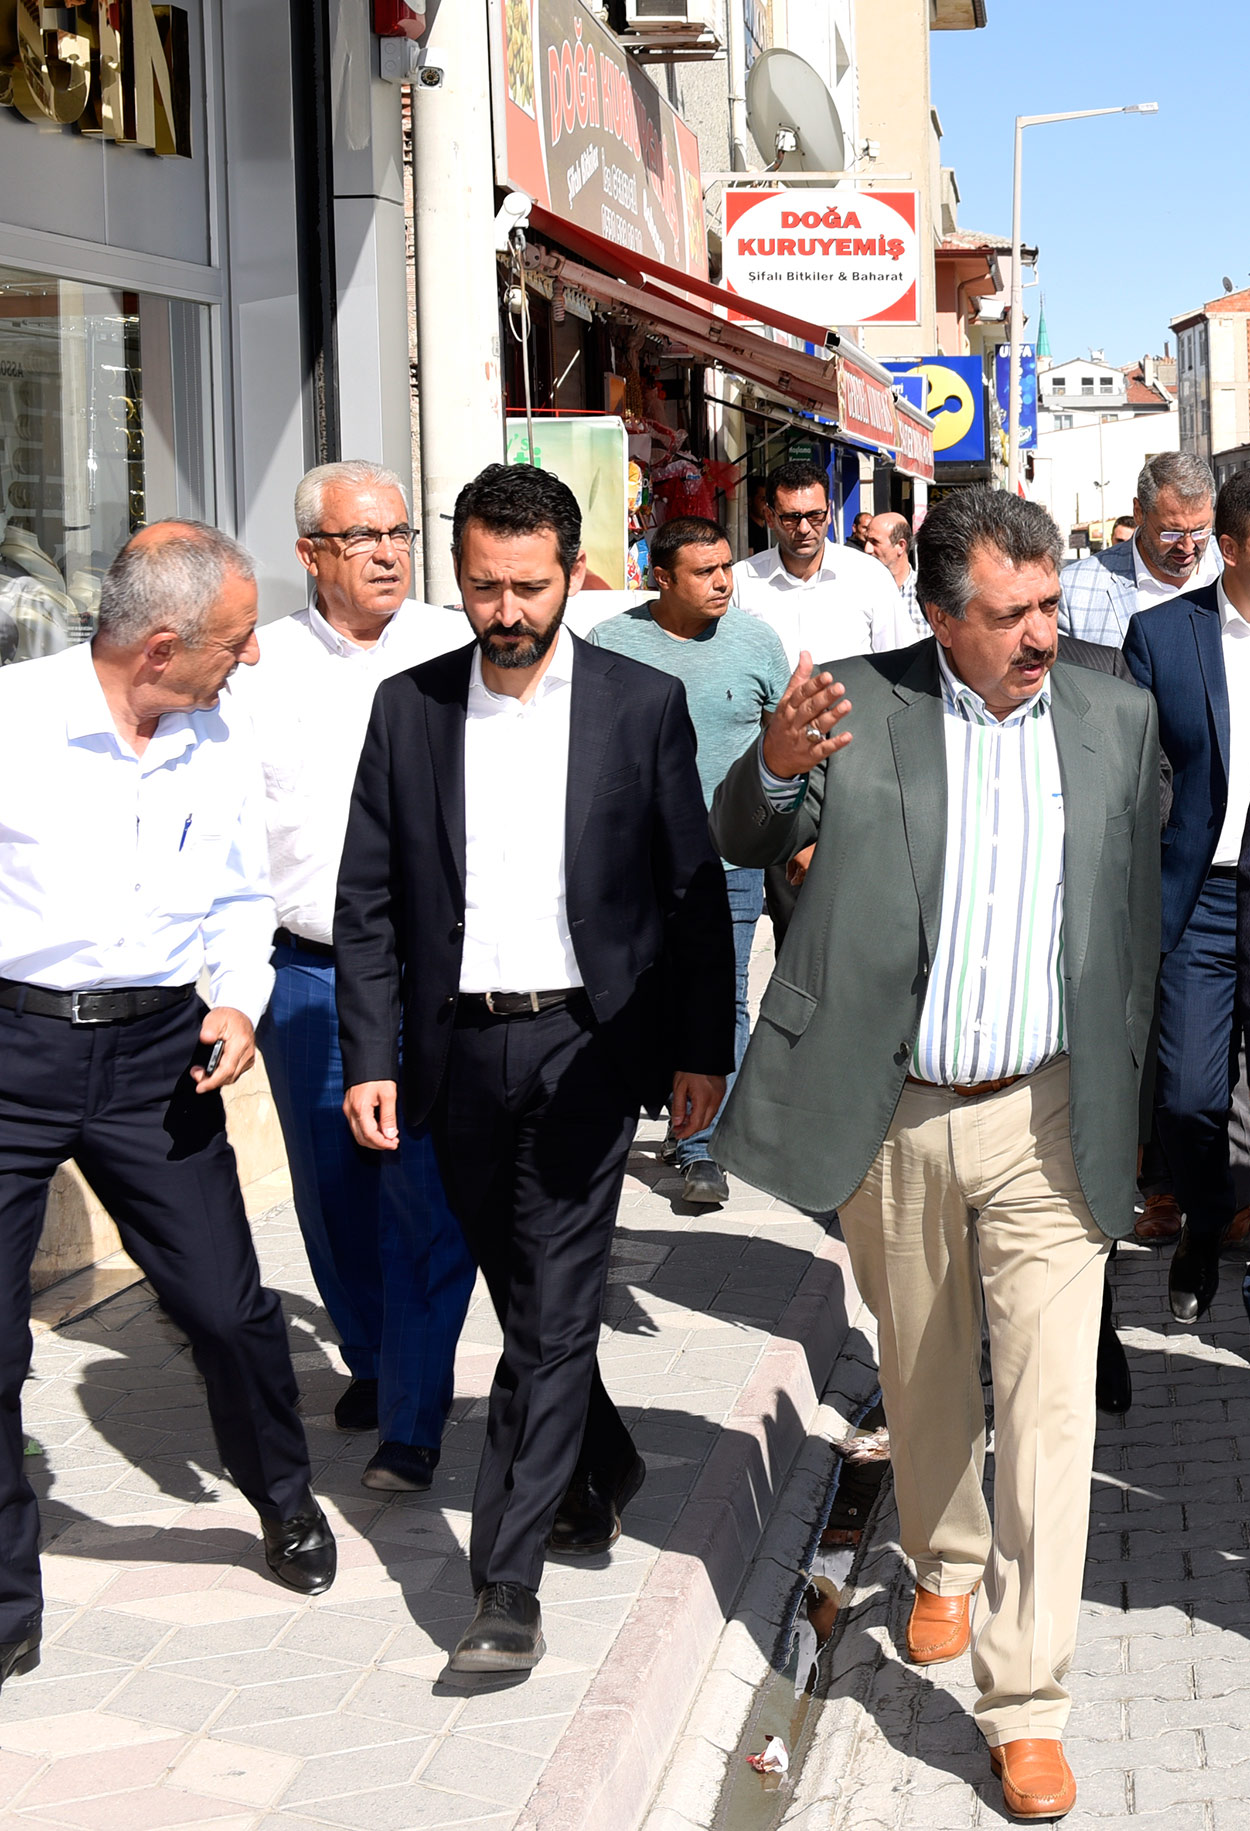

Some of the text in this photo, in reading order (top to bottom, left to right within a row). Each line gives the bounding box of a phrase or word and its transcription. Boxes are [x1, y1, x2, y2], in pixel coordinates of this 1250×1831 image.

[548, 16, 600, 147] DOĞA
[781, 206, 862, 229] DOĞA
[737, 234, 906, 261] KURUYEMİŞ
[748, 271, 904, 283] Şifalı Bitkiler & Baharat
[999, 345, 1033, 358] UFA
